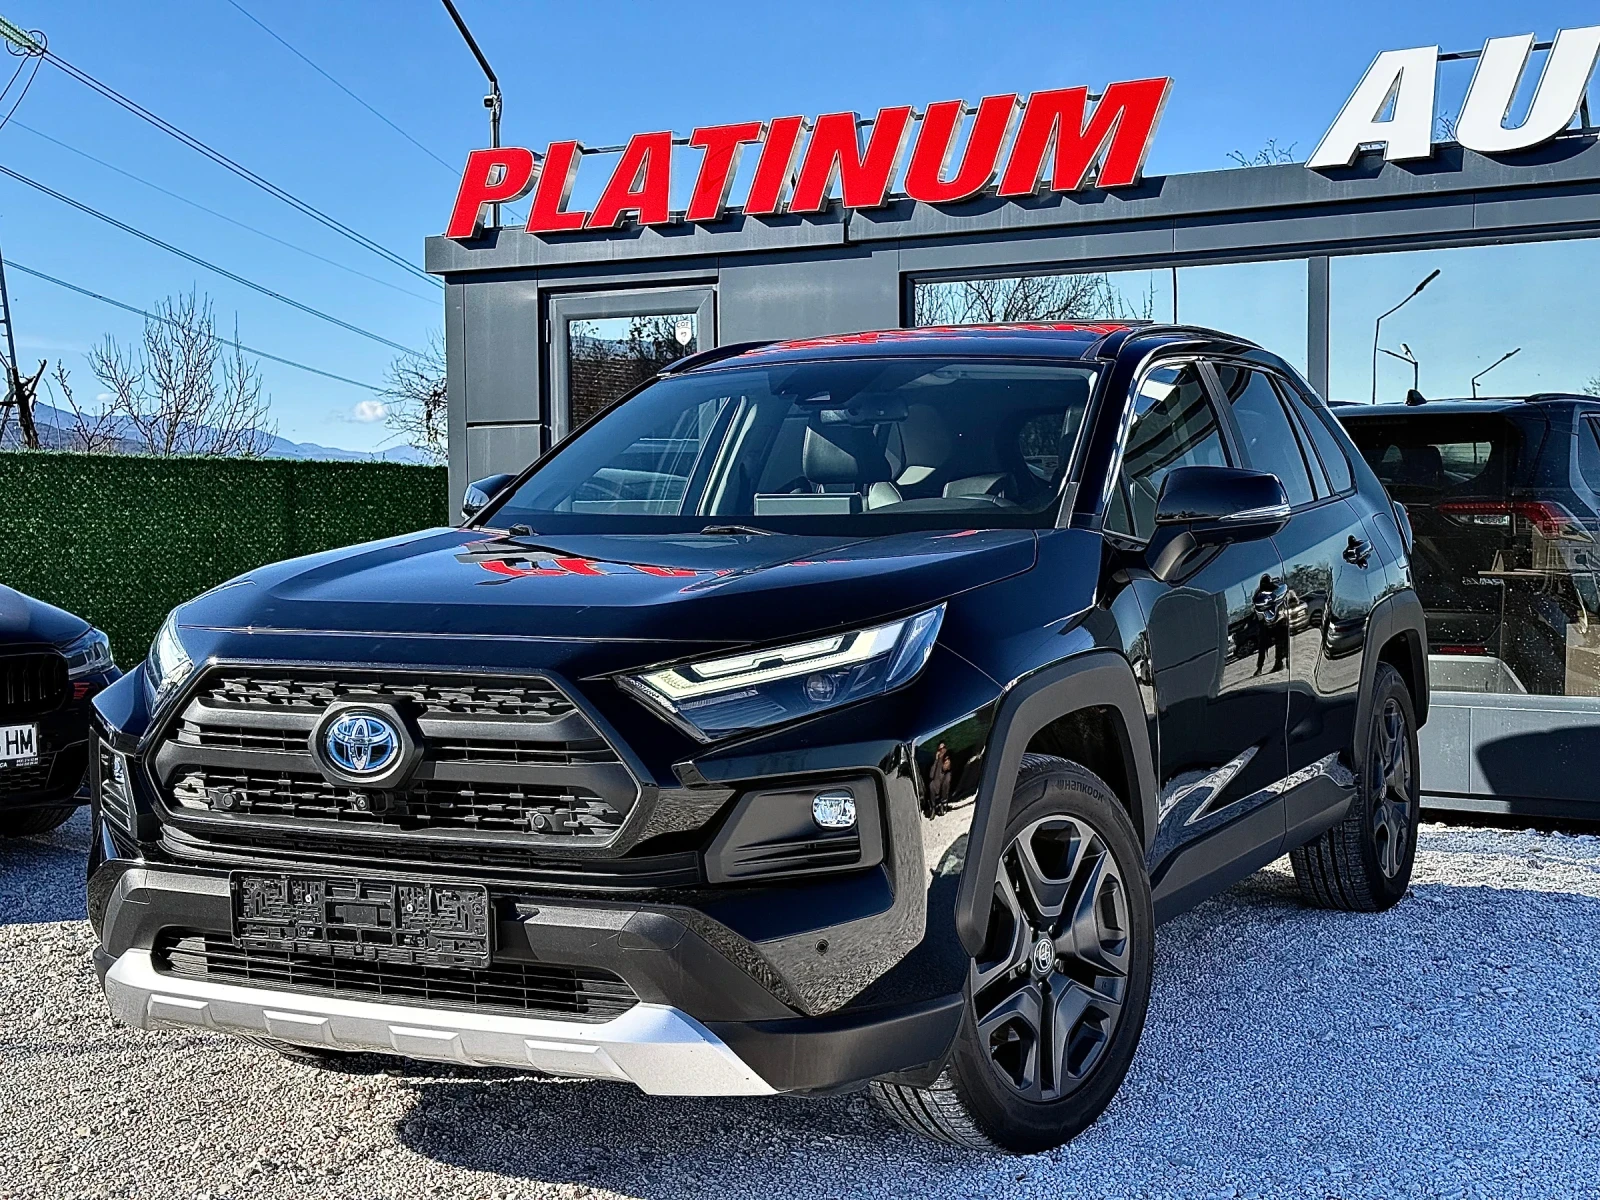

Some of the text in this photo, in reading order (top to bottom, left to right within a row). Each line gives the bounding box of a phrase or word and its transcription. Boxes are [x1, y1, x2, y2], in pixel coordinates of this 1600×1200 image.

[444, 25, 1600, 240] PLATINUM AU
[5, 728, 33, 756] HM
